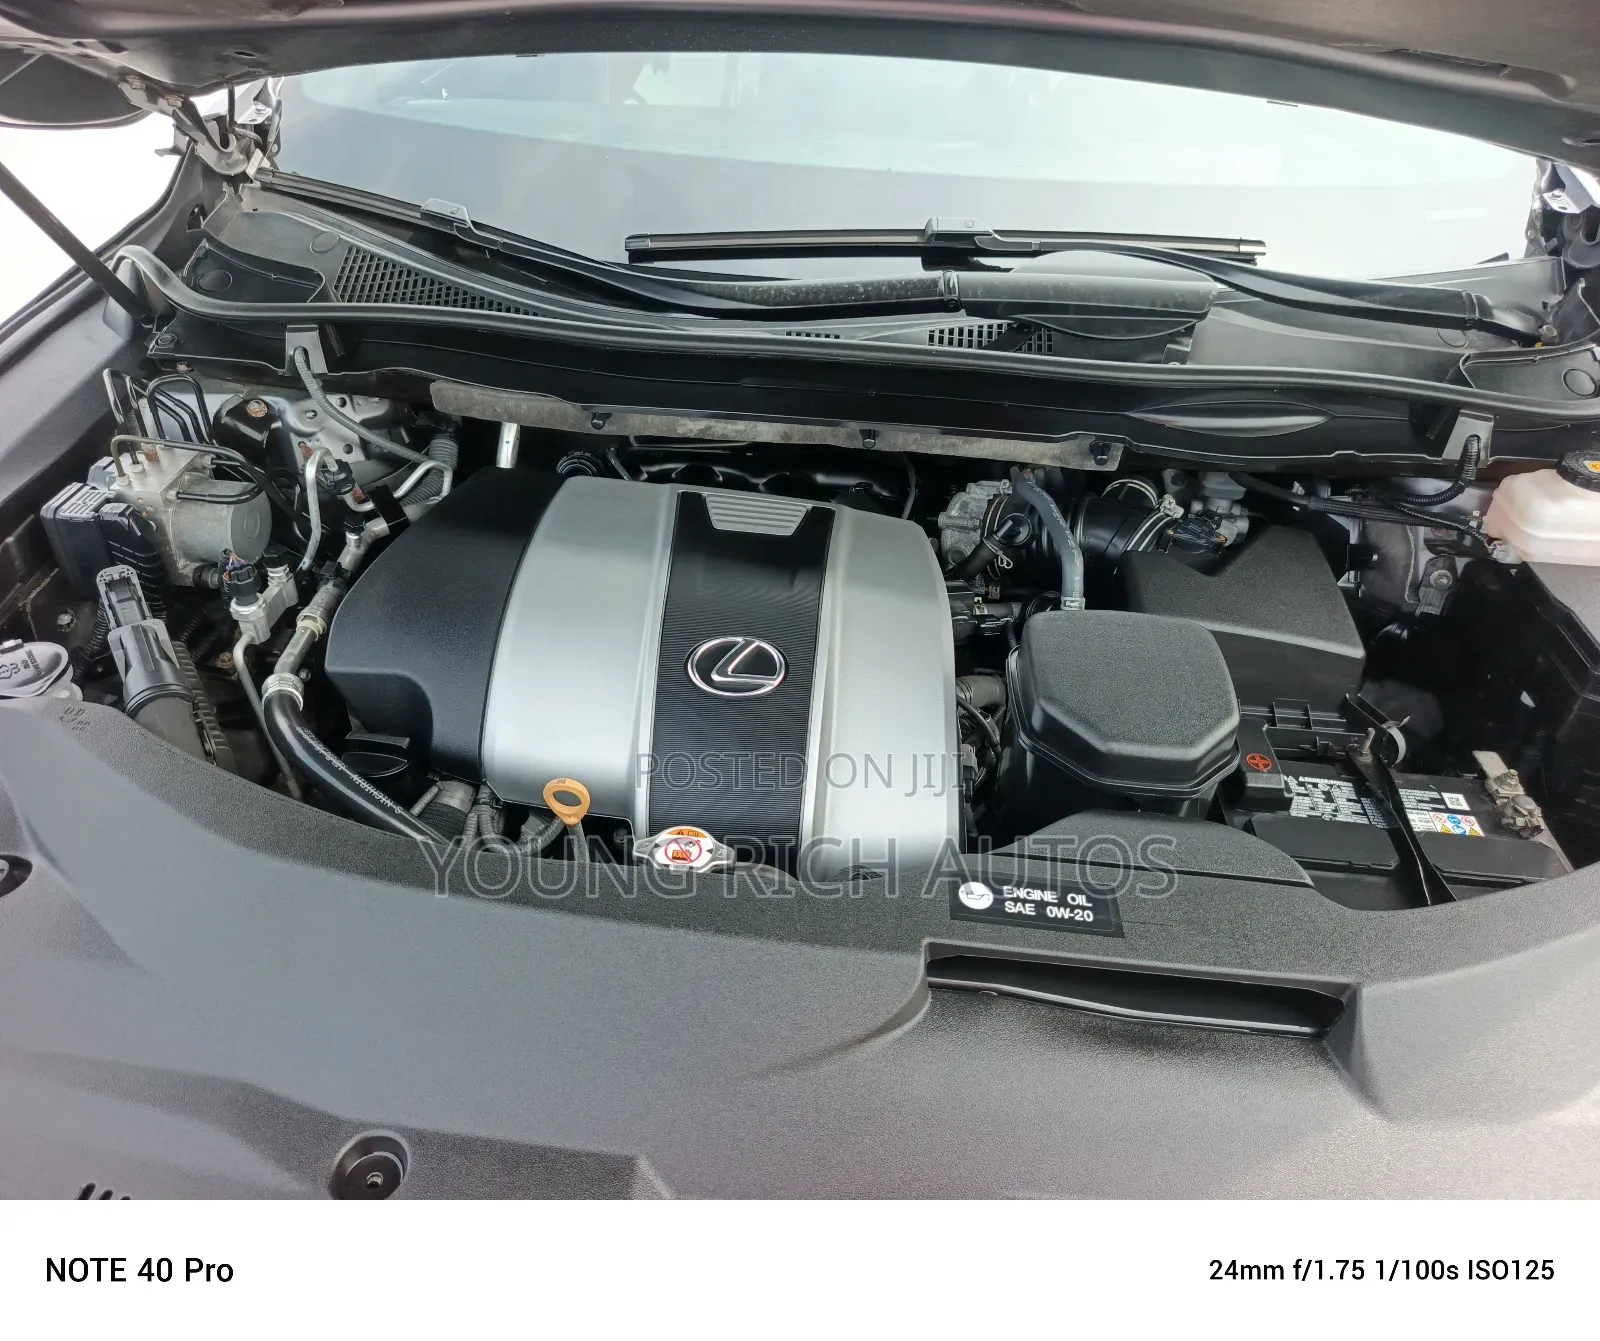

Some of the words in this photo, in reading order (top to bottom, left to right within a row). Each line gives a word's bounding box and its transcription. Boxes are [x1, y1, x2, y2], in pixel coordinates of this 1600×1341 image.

[1003, 885, 1058, 903] ENGINE
[1066, 893, 1093, 907] OIL
[1004, 901, 1036, 915] SAE
[1046, 907, 1094, 922] 0W-20
